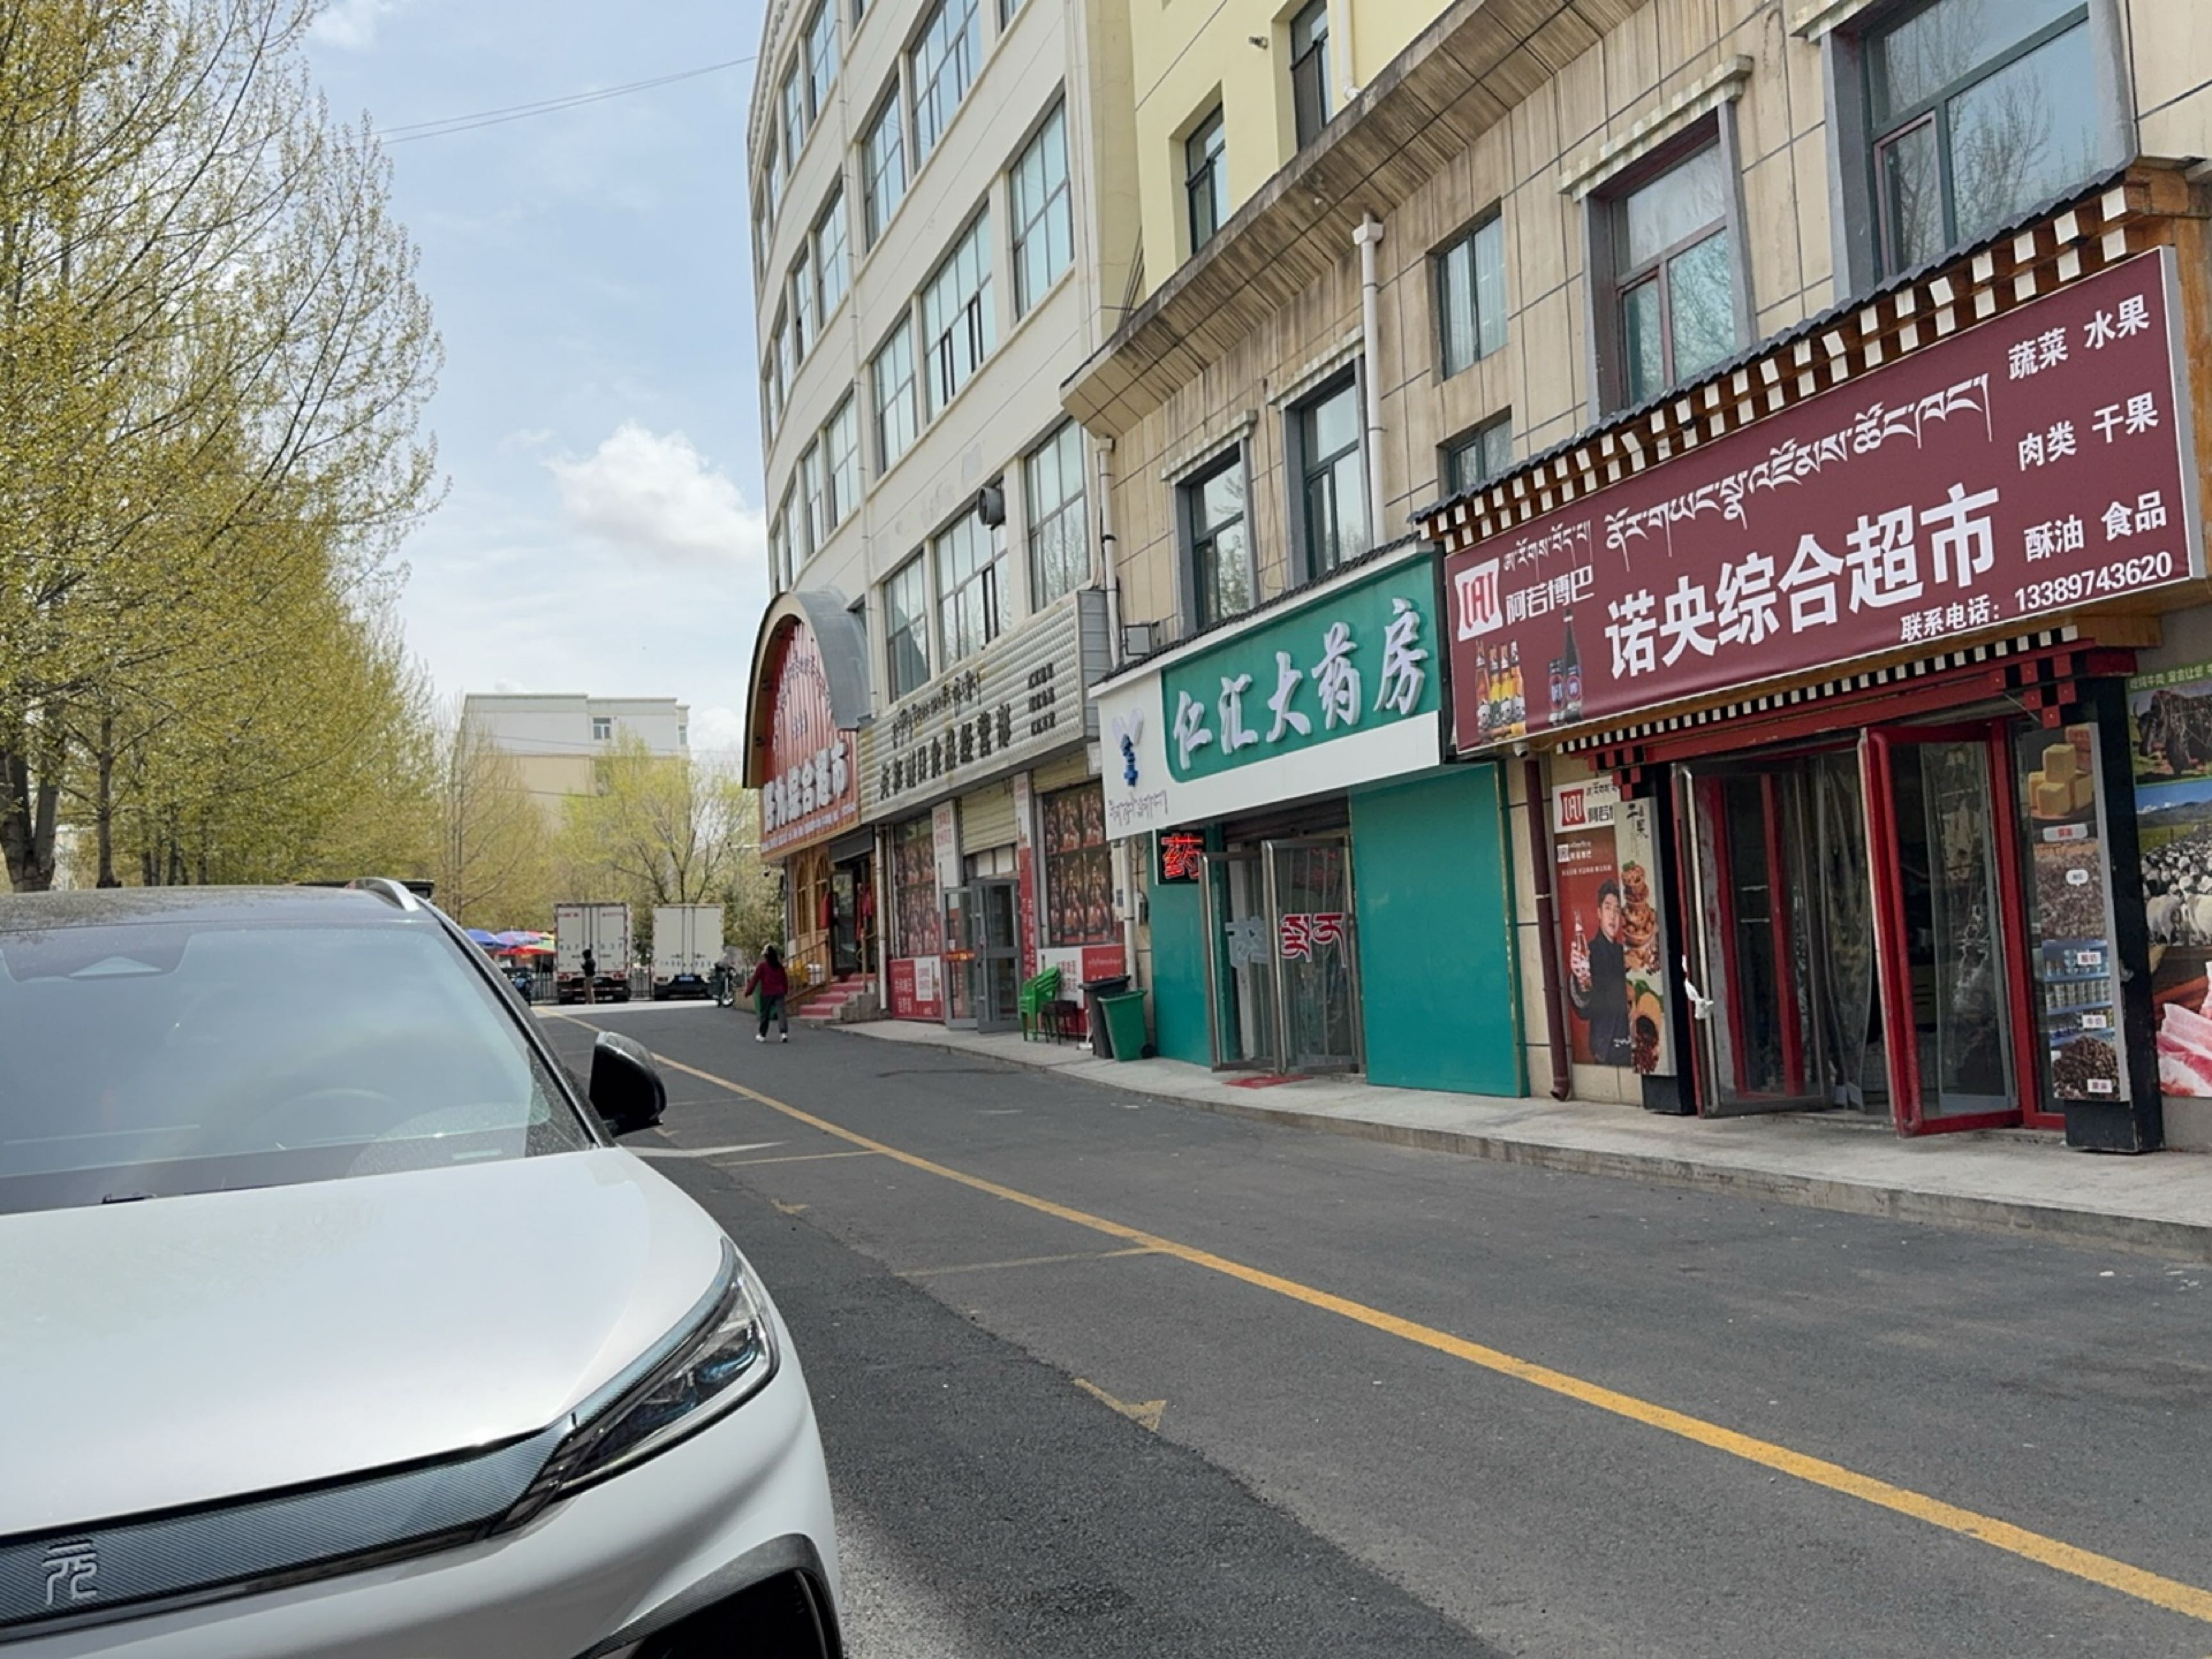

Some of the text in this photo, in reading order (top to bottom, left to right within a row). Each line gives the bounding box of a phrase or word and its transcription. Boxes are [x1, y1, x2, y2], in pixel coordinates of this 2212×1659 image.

[2008, 294, 2150, 380] 蔬菜 水果
[2018, 392, 2159, 472] 肉类 干果
[2024, 490, 2167, 563] 酥油 食品
[1505, 564, 1595, 626] 阿若博巴
[1604, 482, 2000, 680] 诺央综合超市
[1900, 551, 2172, 642] 联系电话： 13389743620
[1173, 597, 1429, 771] 仁汇大药房
[1160, 833, 1203, 880] 药
[41, 1539, 98, 1605] 元
